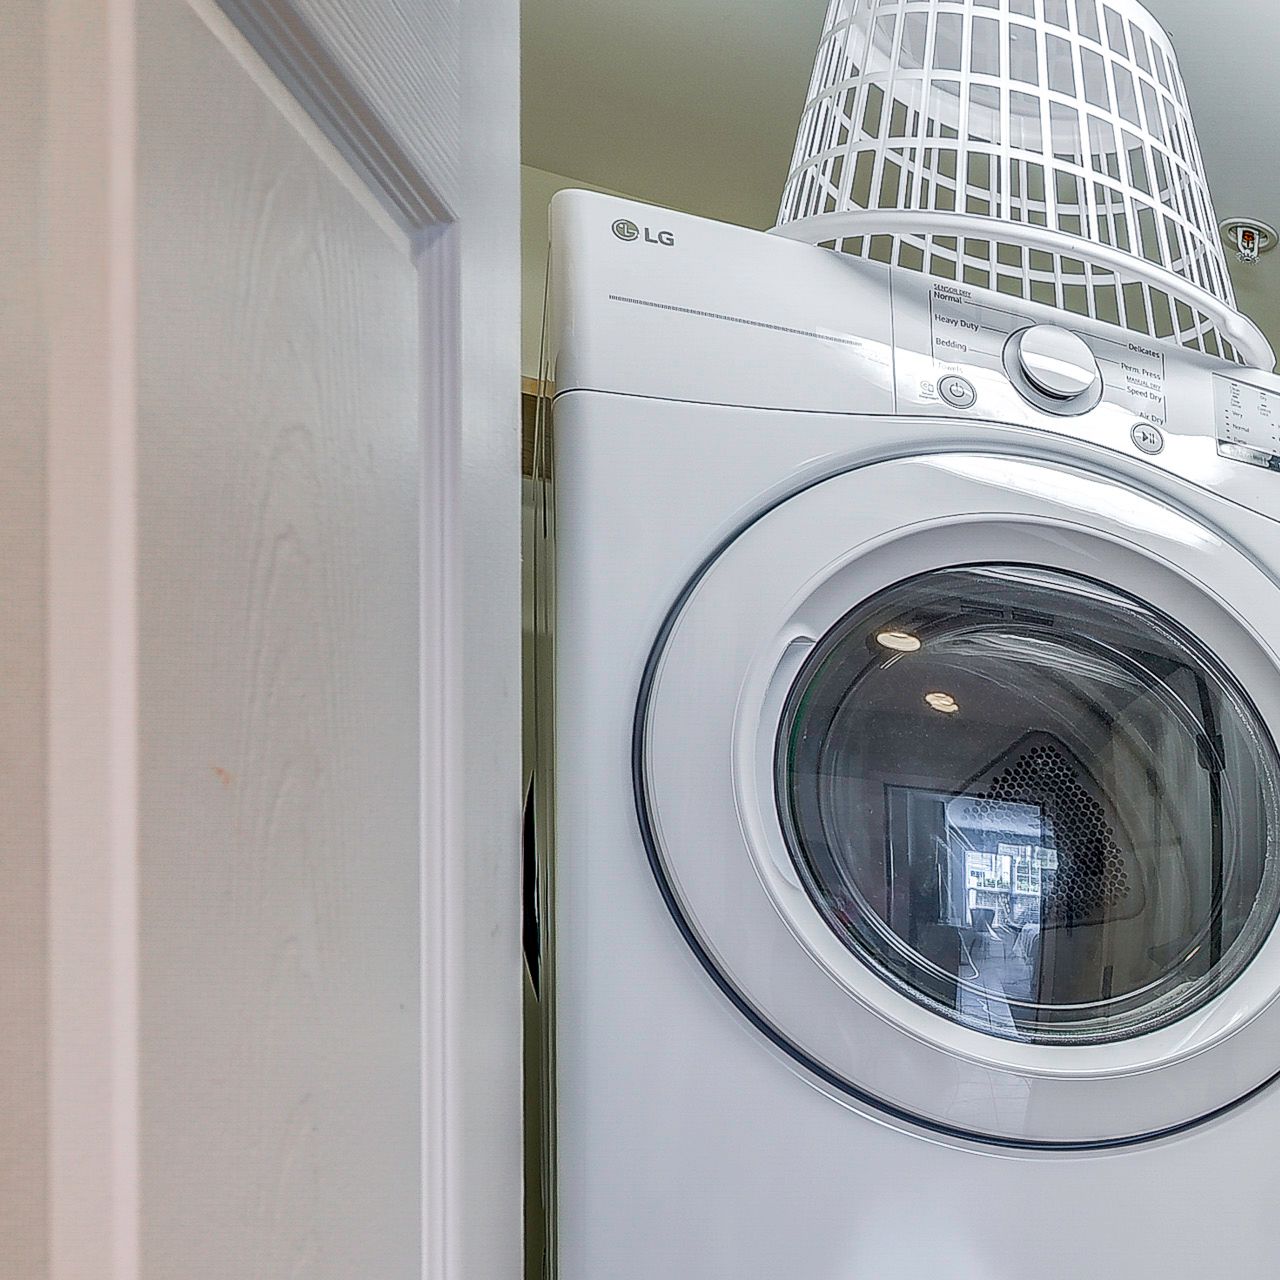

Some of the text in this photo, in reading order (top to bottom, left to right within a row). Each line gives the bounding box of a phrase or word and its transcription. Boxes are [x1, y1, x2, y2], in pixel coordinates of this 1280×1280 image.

[644, 227, 675, 247] LG
[933, 291, 963, 304] Normal
[934, 314, 980, 332] Heavy Duty
[935, 337, 967, 352] Bedding
[1128, 343, 1161, 359] Delicates
[1120, 362, 1161, 381] Perm. Press
[1126, 385, 1162, 403] Speed Dry
[1139, 411, 1164, 426] Air Dry
